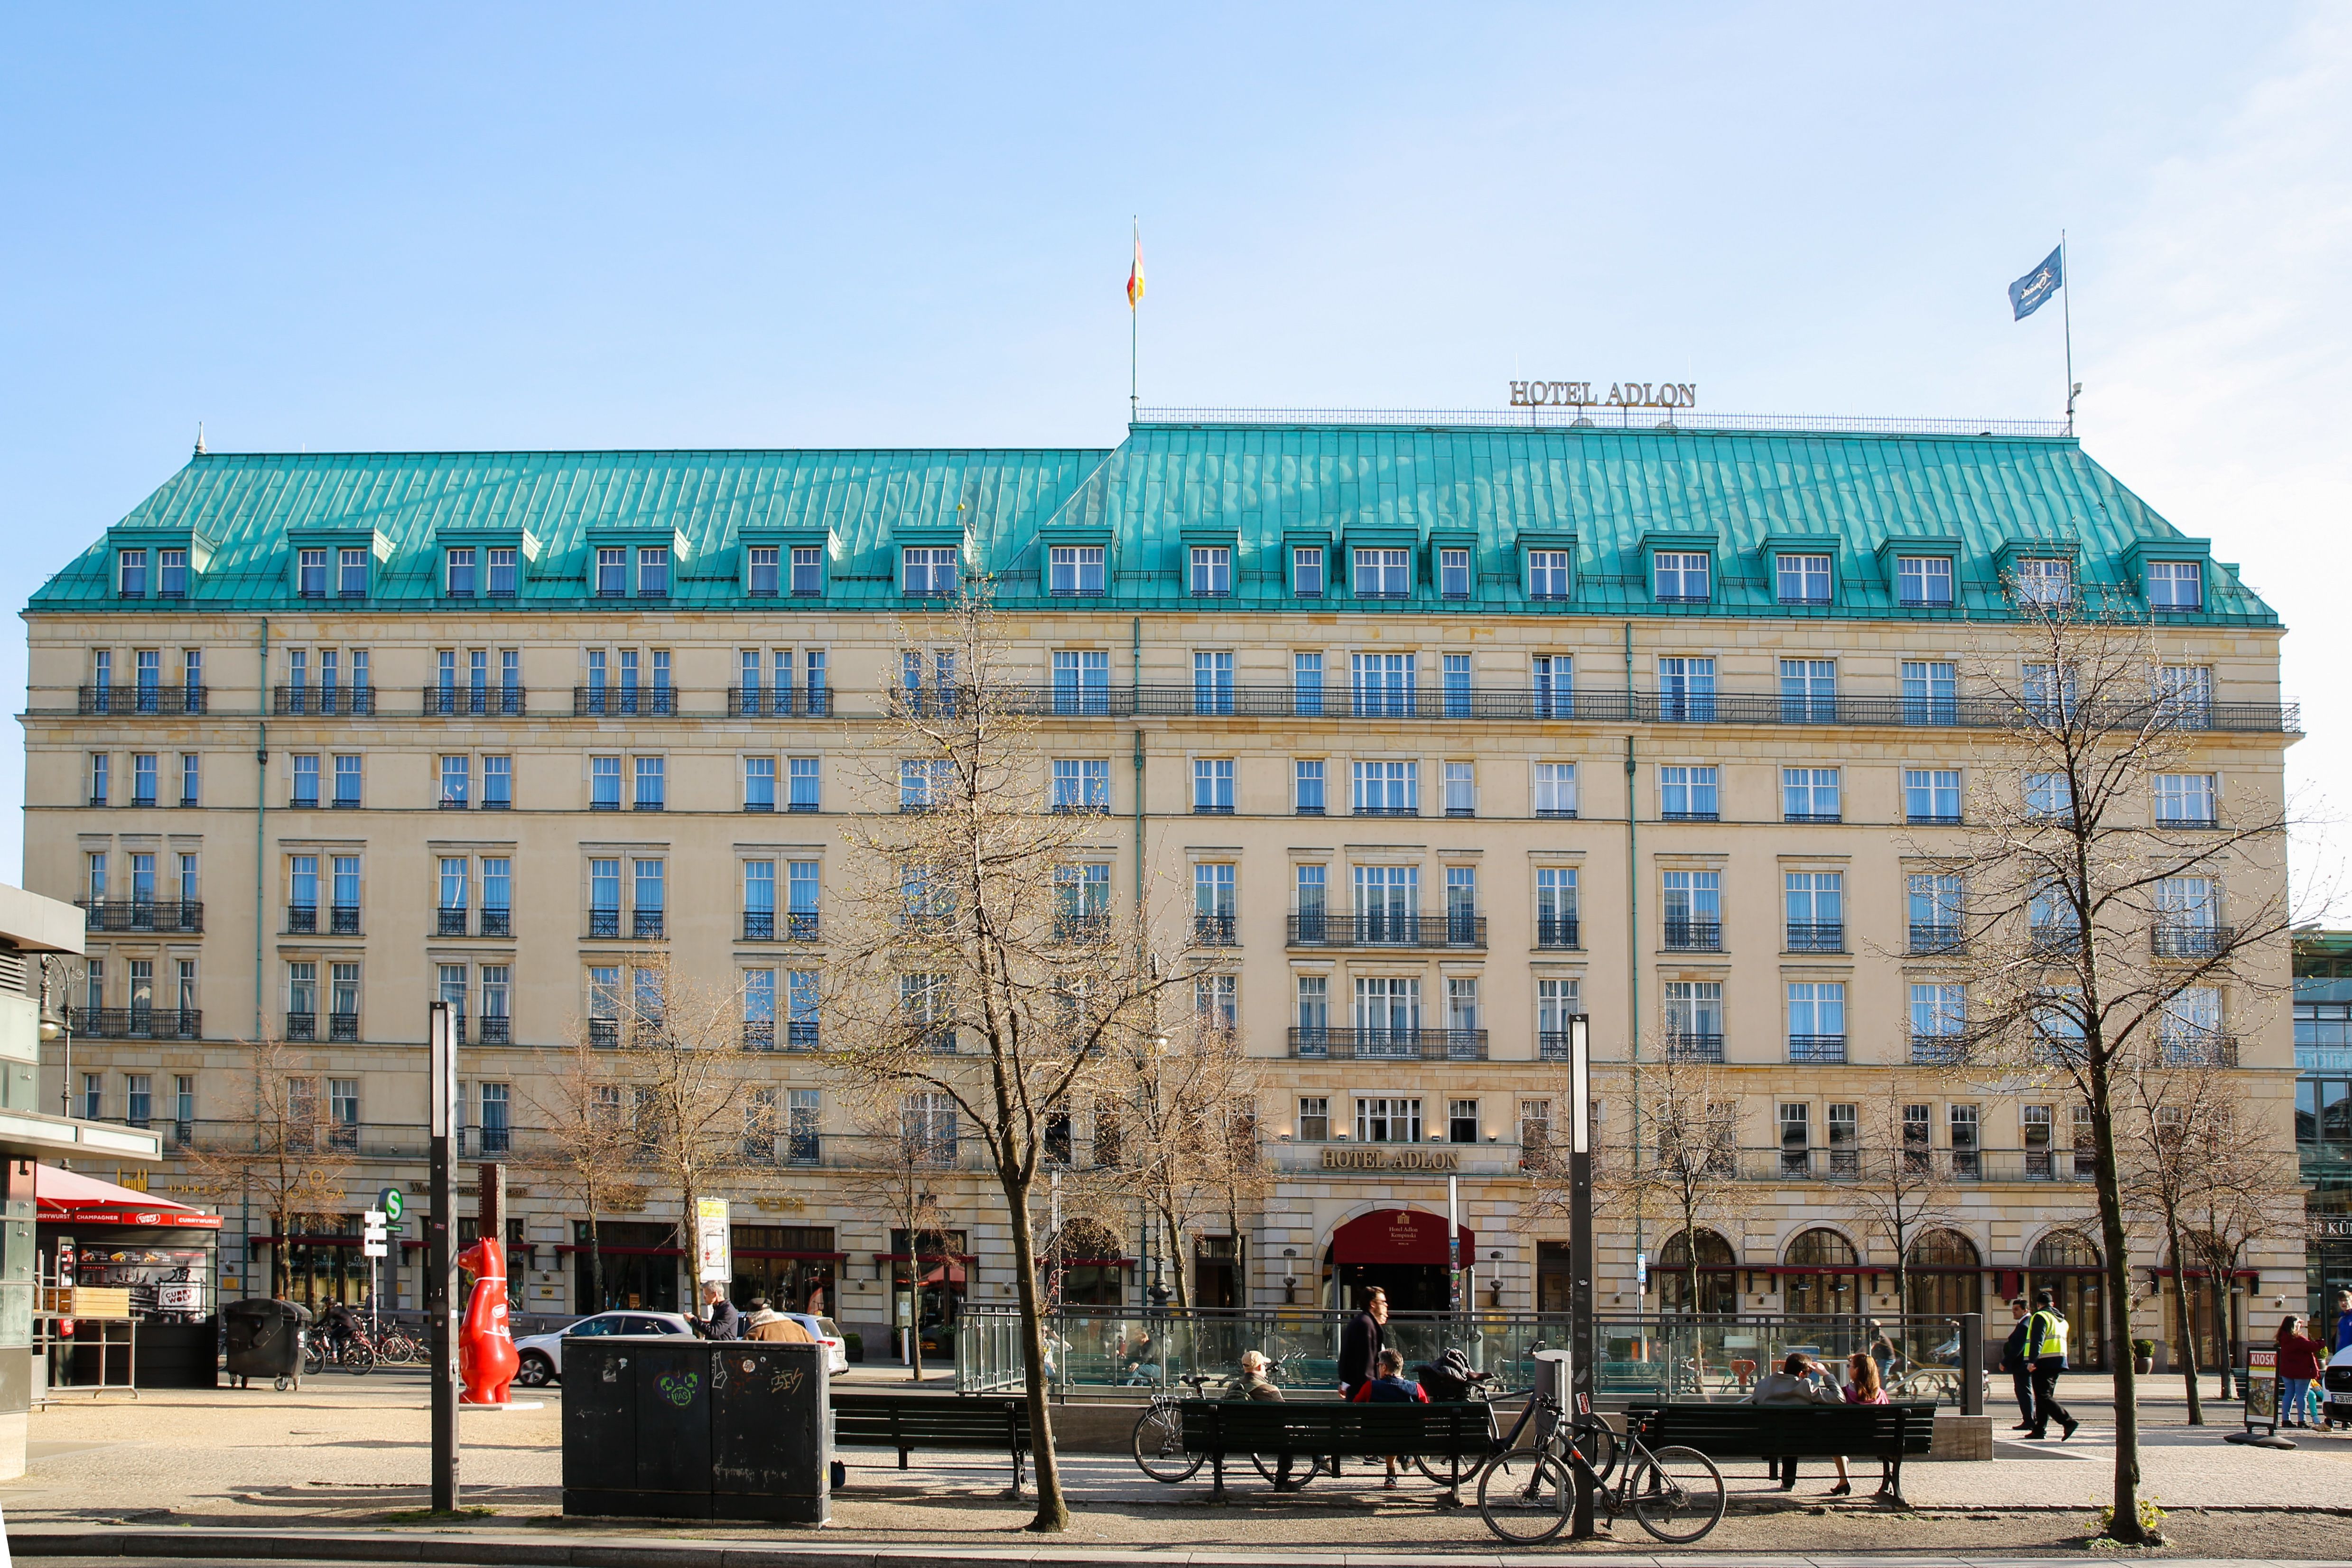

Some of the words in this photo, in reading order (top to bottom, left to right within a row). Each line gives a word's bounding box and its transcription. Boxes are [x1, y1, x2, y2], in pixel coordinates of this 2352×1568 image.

[1509, 380, 1598, 406] HOTEL
[1605, 382, 1697, 407] ADLON
[1322, 1150, 1387, 1168] HOTEL
[1392, 1151, 1459, 1169] ADLON
[388, 1191, 400, 1219] S
[754, 1197, 805, 1211] TUMI
[2328, 1220, 2352, 1234] KÜ
[166, 1288, 192, 1298] CURRY
[168, 1294, 192, 1304] WOLF
[2251, 1354, 2275, 1365] KIOSK
